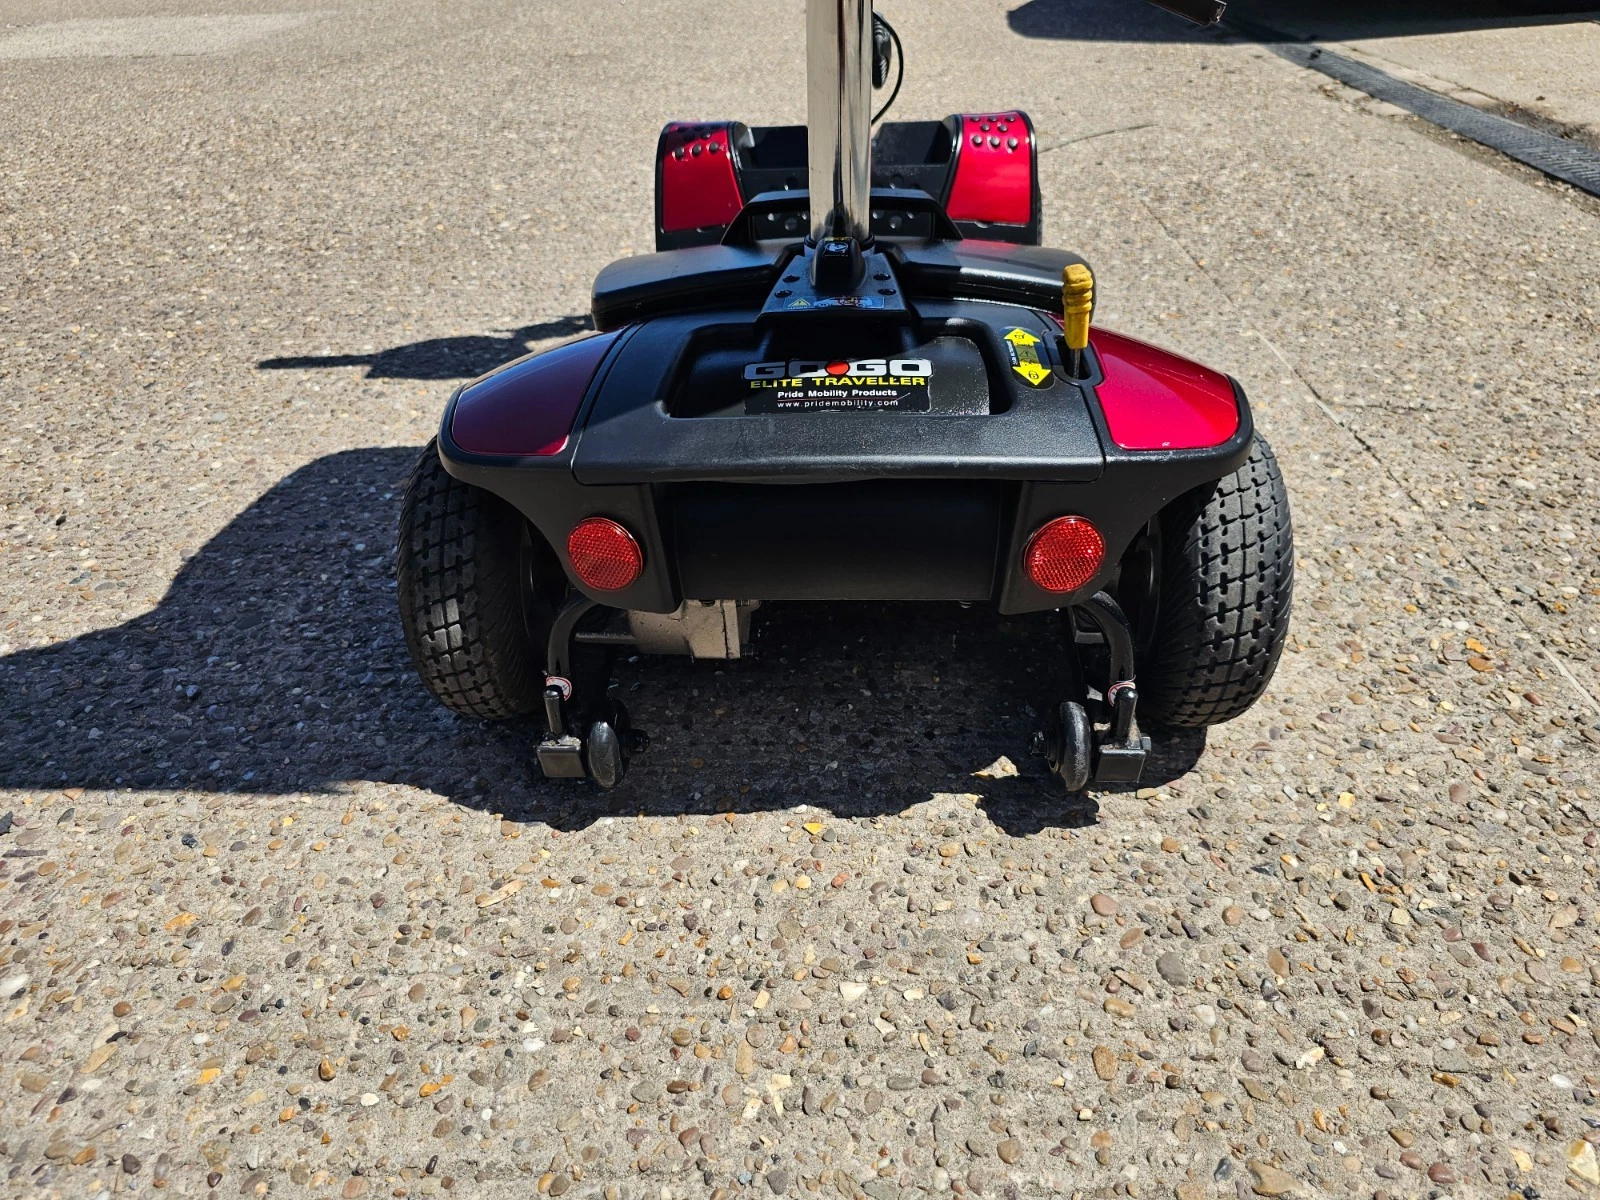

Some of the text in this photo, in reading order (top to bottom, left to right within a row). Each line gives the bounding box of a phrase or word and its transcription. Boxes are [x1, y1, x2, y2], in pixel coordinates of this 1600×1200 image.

[750, 376, 925, 388] ELITE TRAVELLER
[777, 388, 898, 398] Pride Mobility Products
[777, 400, 899, 408] www.pridemobility.com
